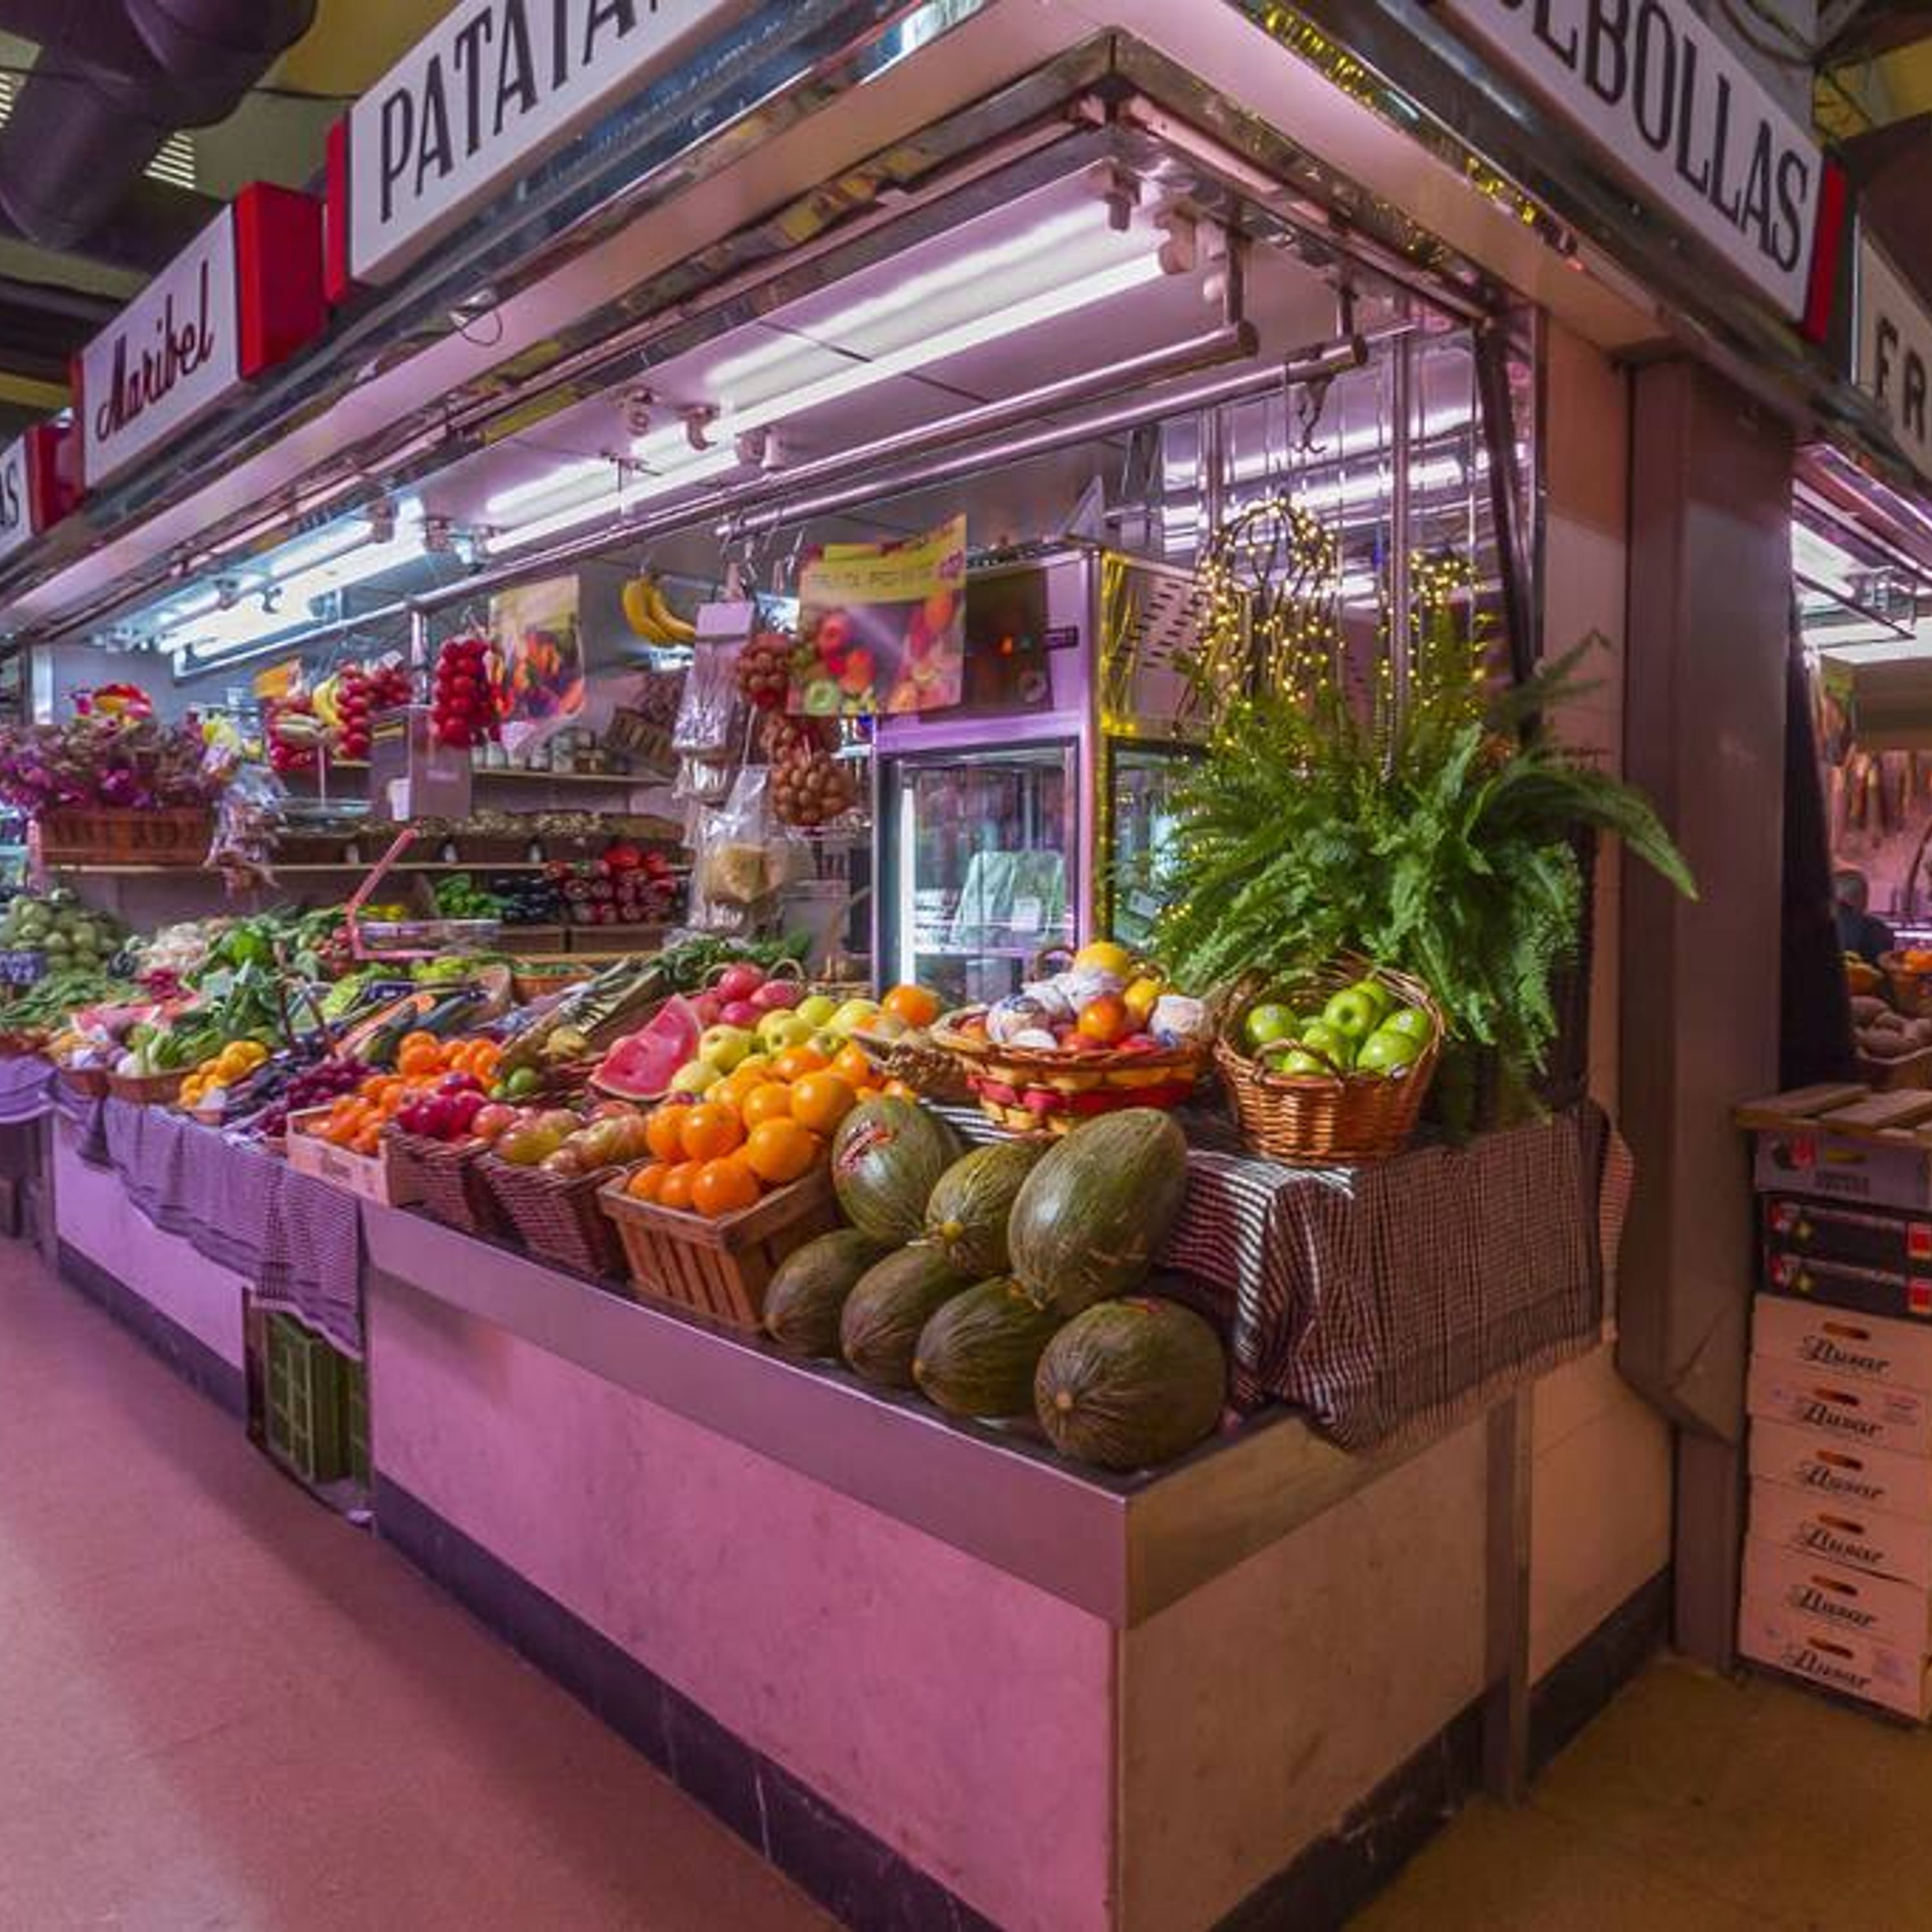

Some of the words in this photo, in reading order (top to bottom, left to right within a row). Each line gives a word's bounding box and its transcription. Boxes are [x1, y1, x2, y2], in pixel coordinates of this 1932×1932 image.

[381, 0, 657, 223] PATAT
[1499, 0, 1808, 272] BOLLAS
[95, 260, 214, 442] Maribel
[0, 460, 20, 529] S
